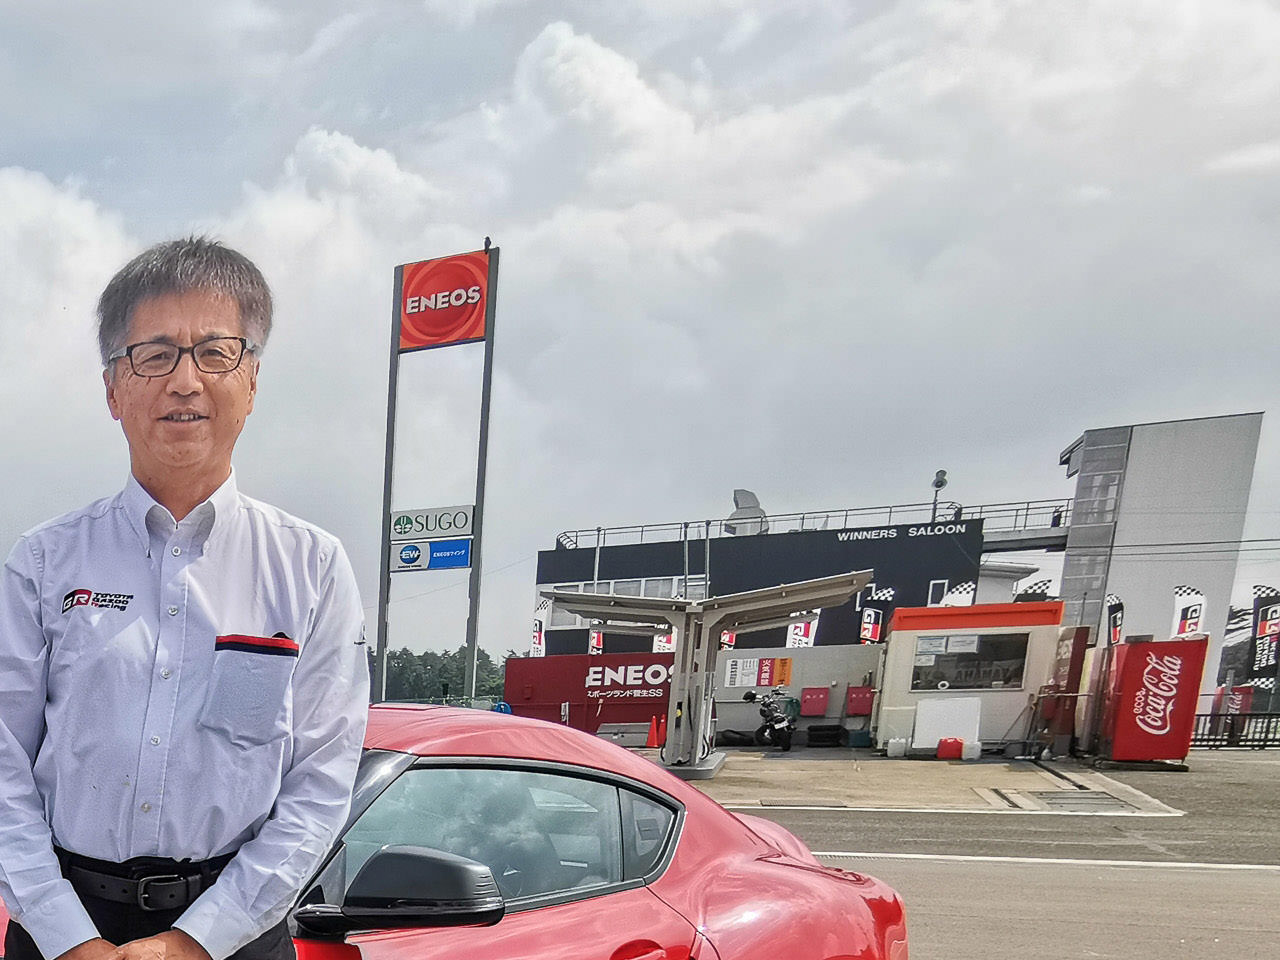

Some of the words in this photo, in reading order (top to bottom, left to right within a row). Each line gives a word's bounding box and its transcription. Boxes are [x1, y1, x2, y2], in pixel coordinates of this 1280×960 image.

[405, 286, 481, 314] ENEOS
[413, 511, 468, 533] SUGO
[837, 528, 898, 541] WINNERS
[908, 524, 967, 537] SALOON
[401, 550, 420, 559] EW
[62, 592, 90, 611] GR
[93, 592, 134, 600] TOYOTA
[1135, 651, 1182, 735] Coca-Cola
